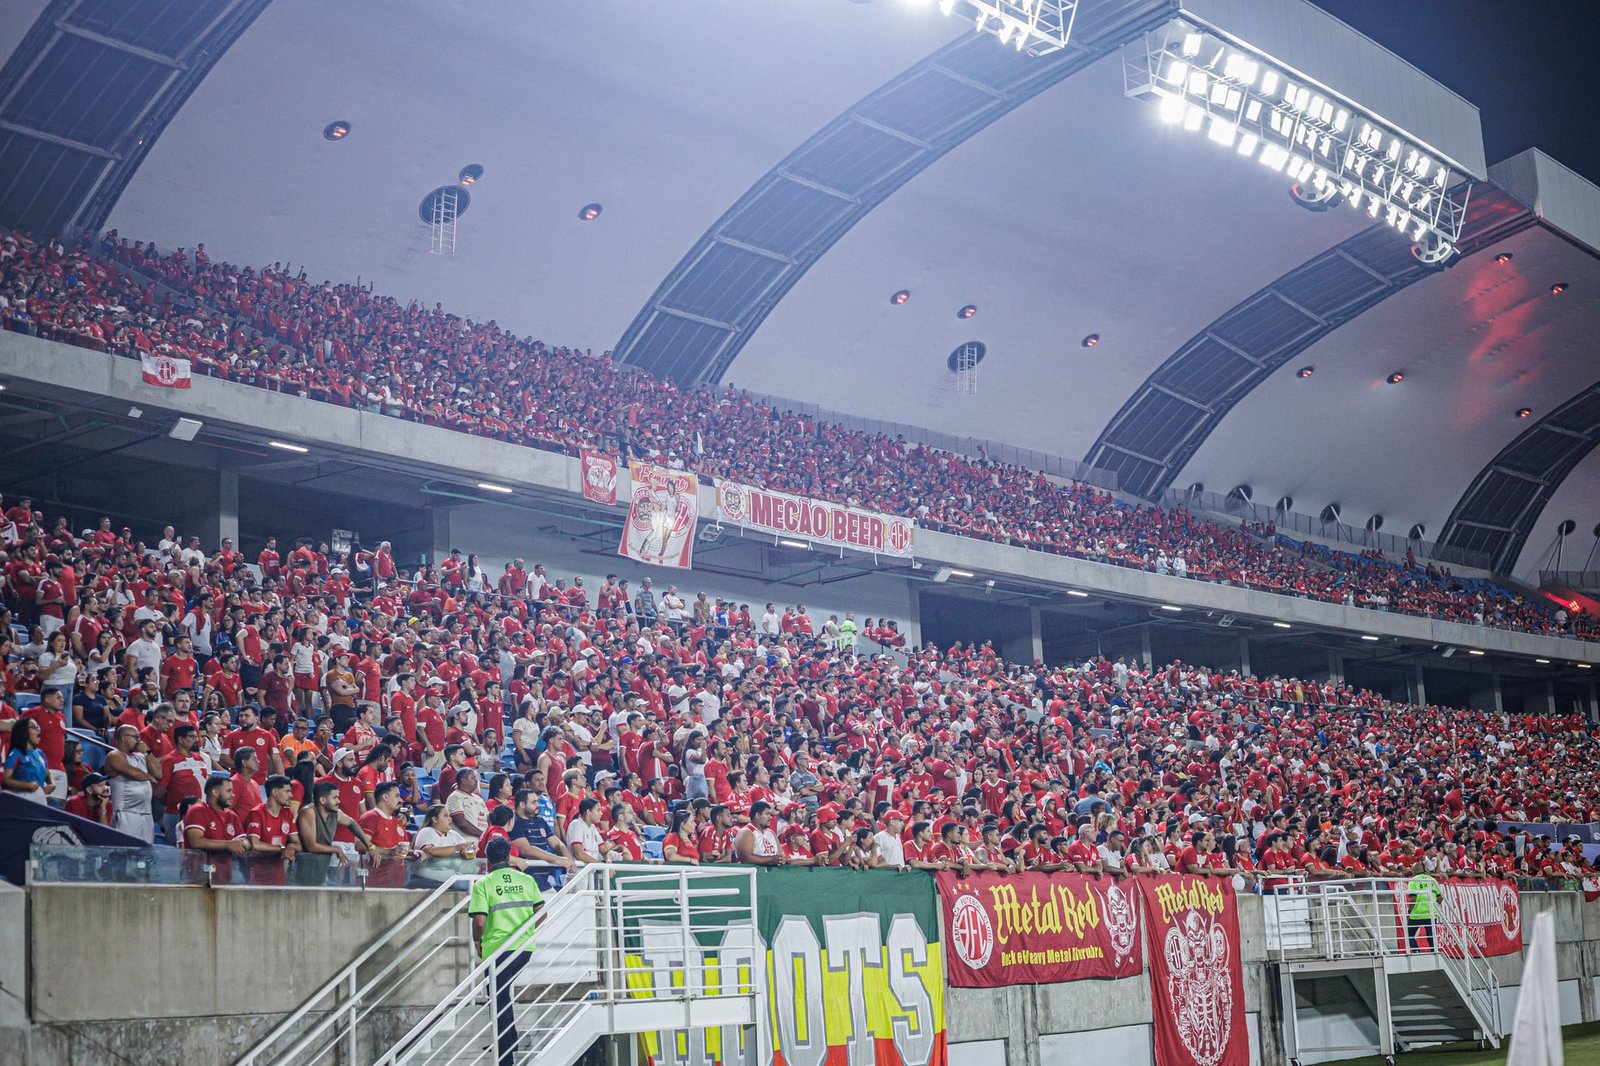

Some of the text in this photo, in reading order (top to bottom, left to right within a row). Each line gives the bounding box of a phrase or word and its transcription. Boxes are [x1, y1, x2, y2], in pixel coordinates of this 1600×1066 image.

[749, 490, 885, 552] MECÃO BEER
[989, 882, 1100, 945] Metal Red
[1154, 879, 1225, 924] Metal Red
[1456, 883, 1502, 925] PINTADAS
[957, 906, 987, 960] AFC
[1046, 948, 1072, 964] Metal
